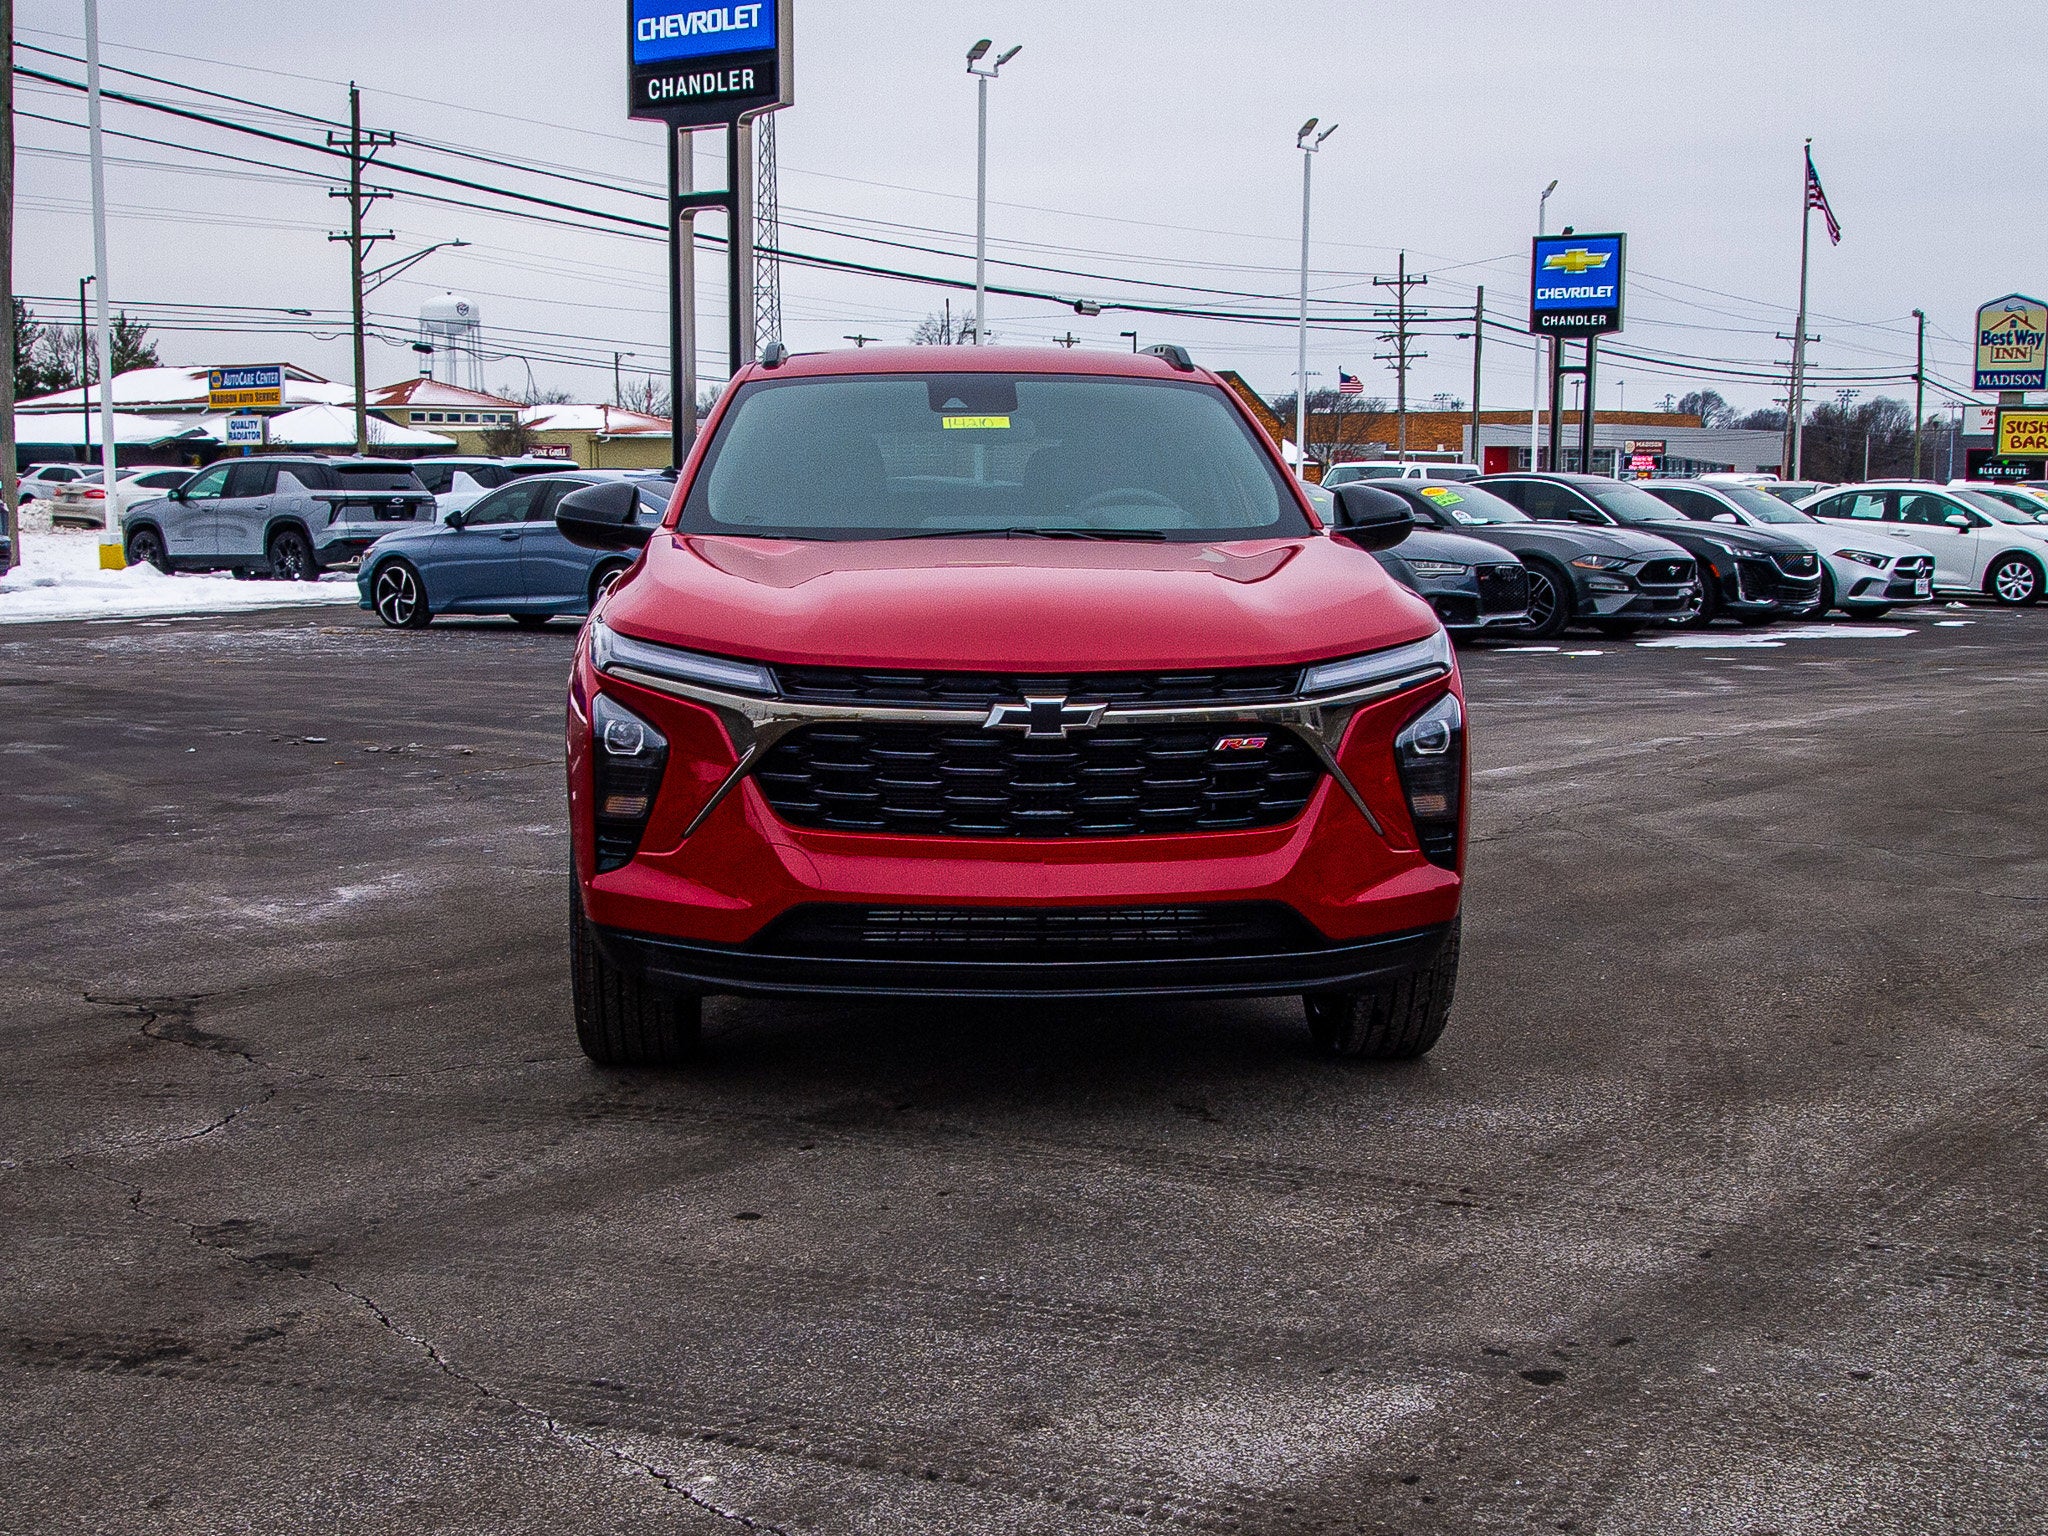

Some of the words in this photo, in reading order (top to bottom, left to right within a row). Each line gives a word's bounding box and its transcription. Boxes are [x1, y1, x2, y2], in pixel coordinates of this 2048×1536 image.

[637, 3, 762, 42] CHEVROLET
[648, 68, 754, 100] CHANDLER
[1537, 285, 1614, 300] CHEVROLET
[1542, 314, 1607, 326] CHANDLER
[1980, 329, 2013, 347] Best
[2014, 329, 2045, 350] Way
[1994, 347, 2029, 359] INN
[1978, 373, 2042, 386] MADISON
[230, 420, 258, 430] QUALITY
[228, 431, 261, 441] RADIATOR
[2010, 435, 2048, 449] BAR
[1978, 467, 2003, 475] BLACK
[2005, 467, 2028, 475] OLIVE
[1214, 737, 1268, 751] RS
